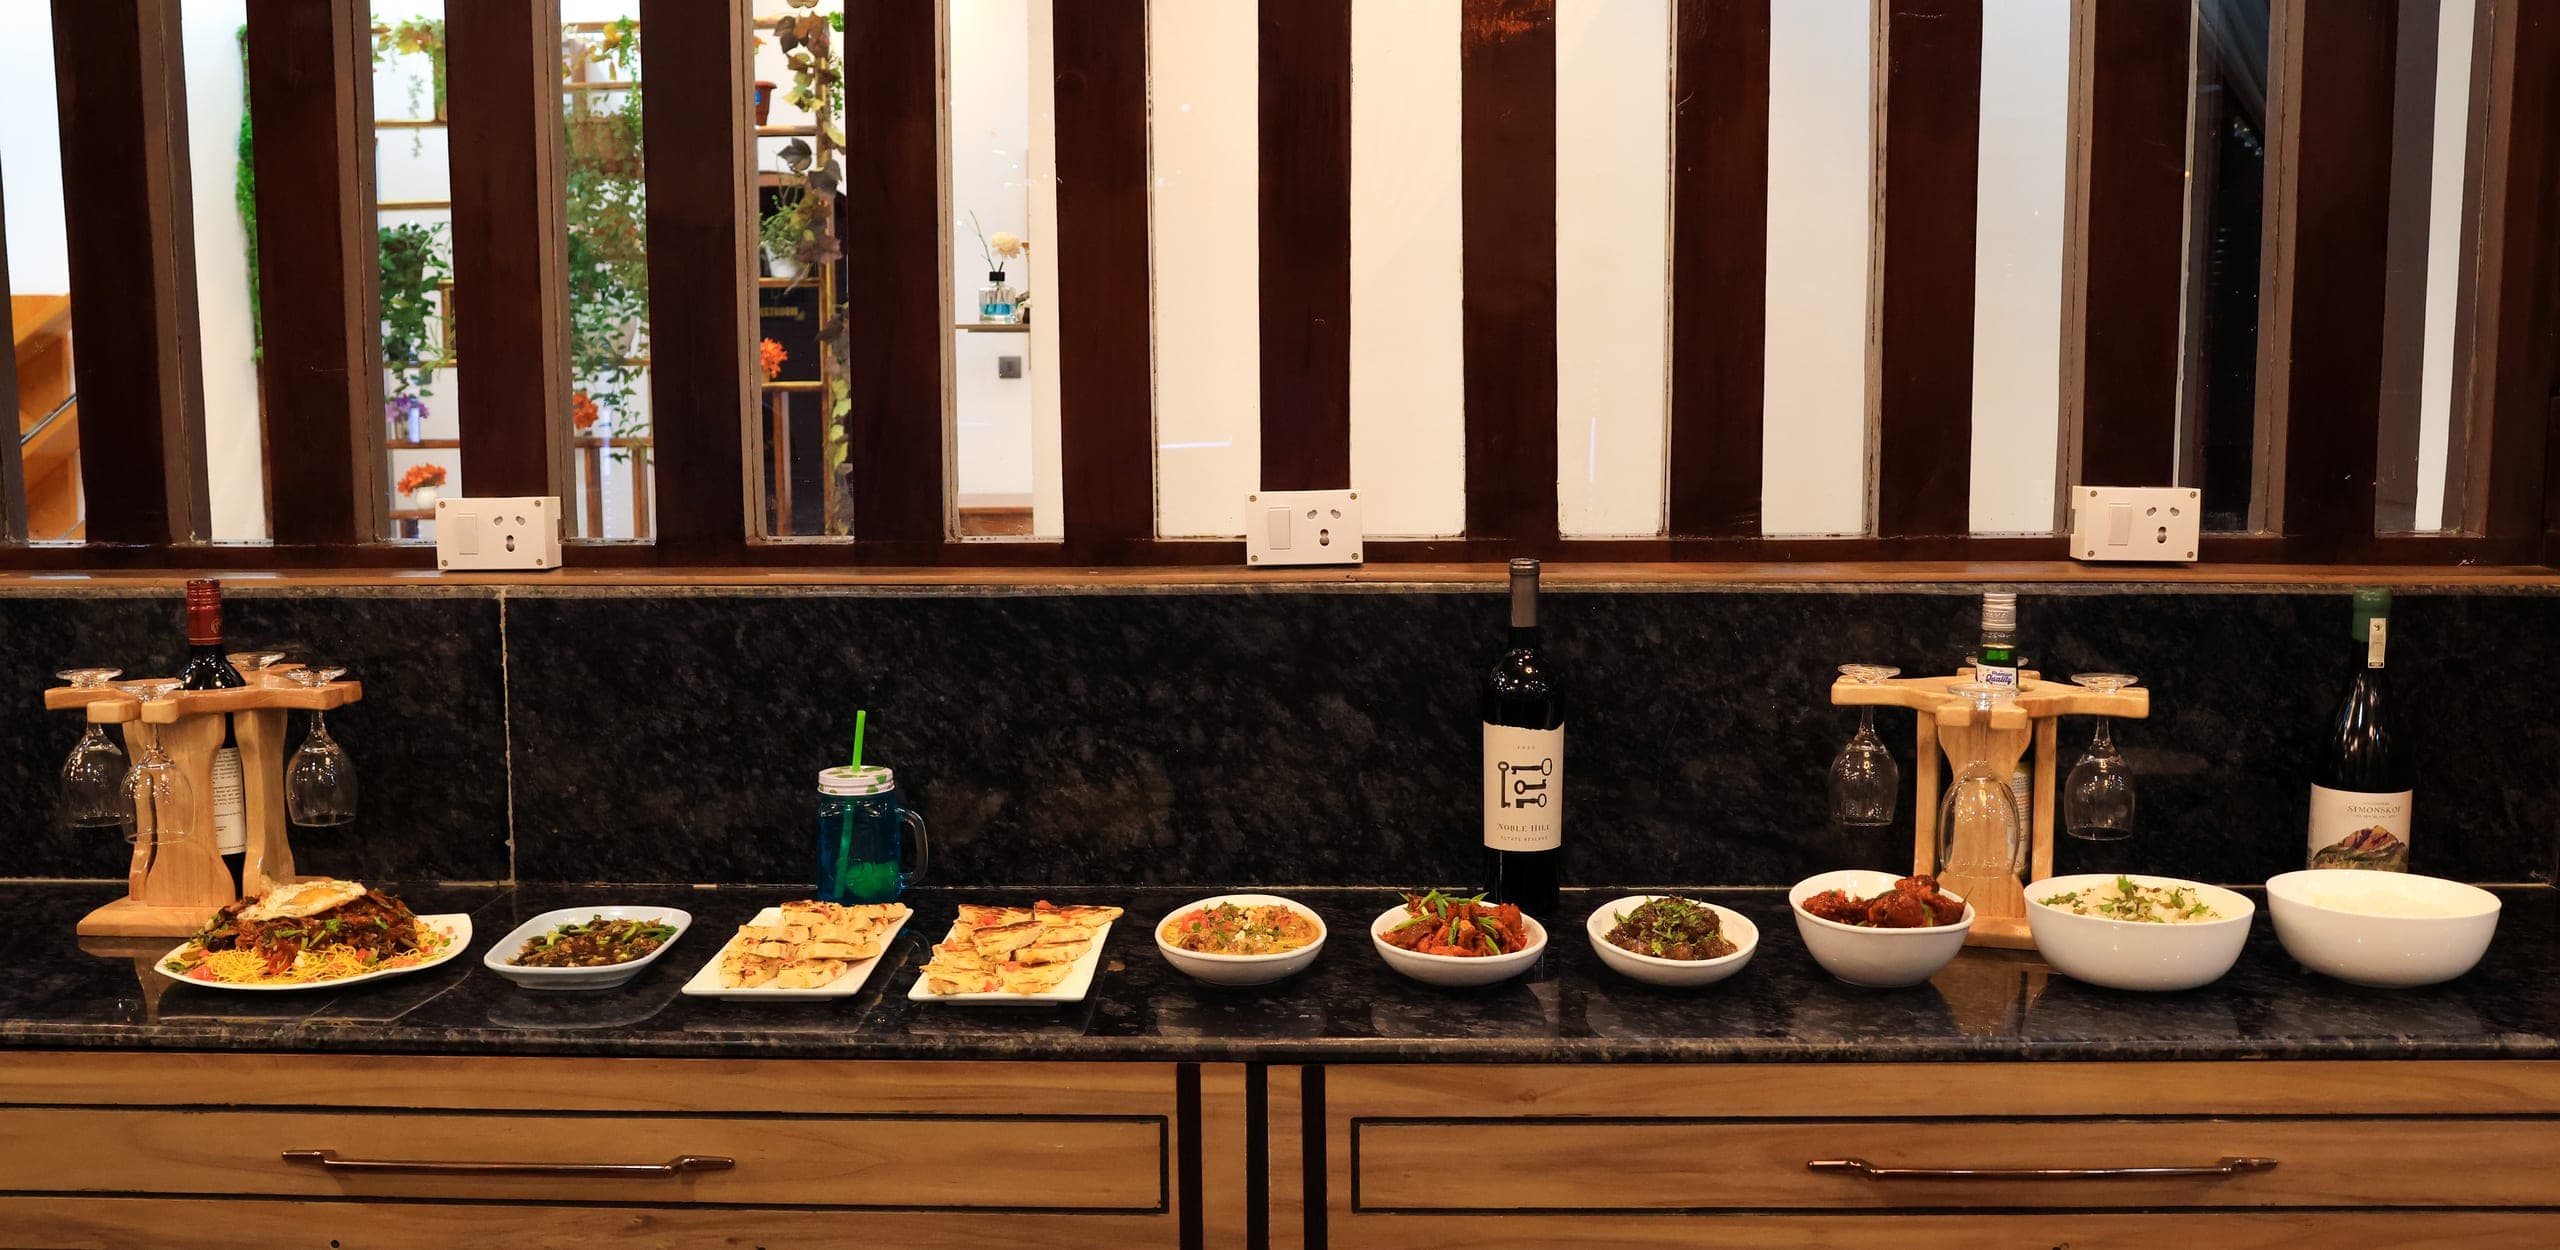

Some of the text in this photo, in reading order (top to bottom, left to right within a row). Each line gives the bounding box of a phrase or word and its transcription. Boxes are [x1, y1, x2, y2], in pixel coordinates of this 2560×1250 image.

[1985, 674, 2012, 685] Quality
[1498, 823, 1550, 833] NOBLE HILL
